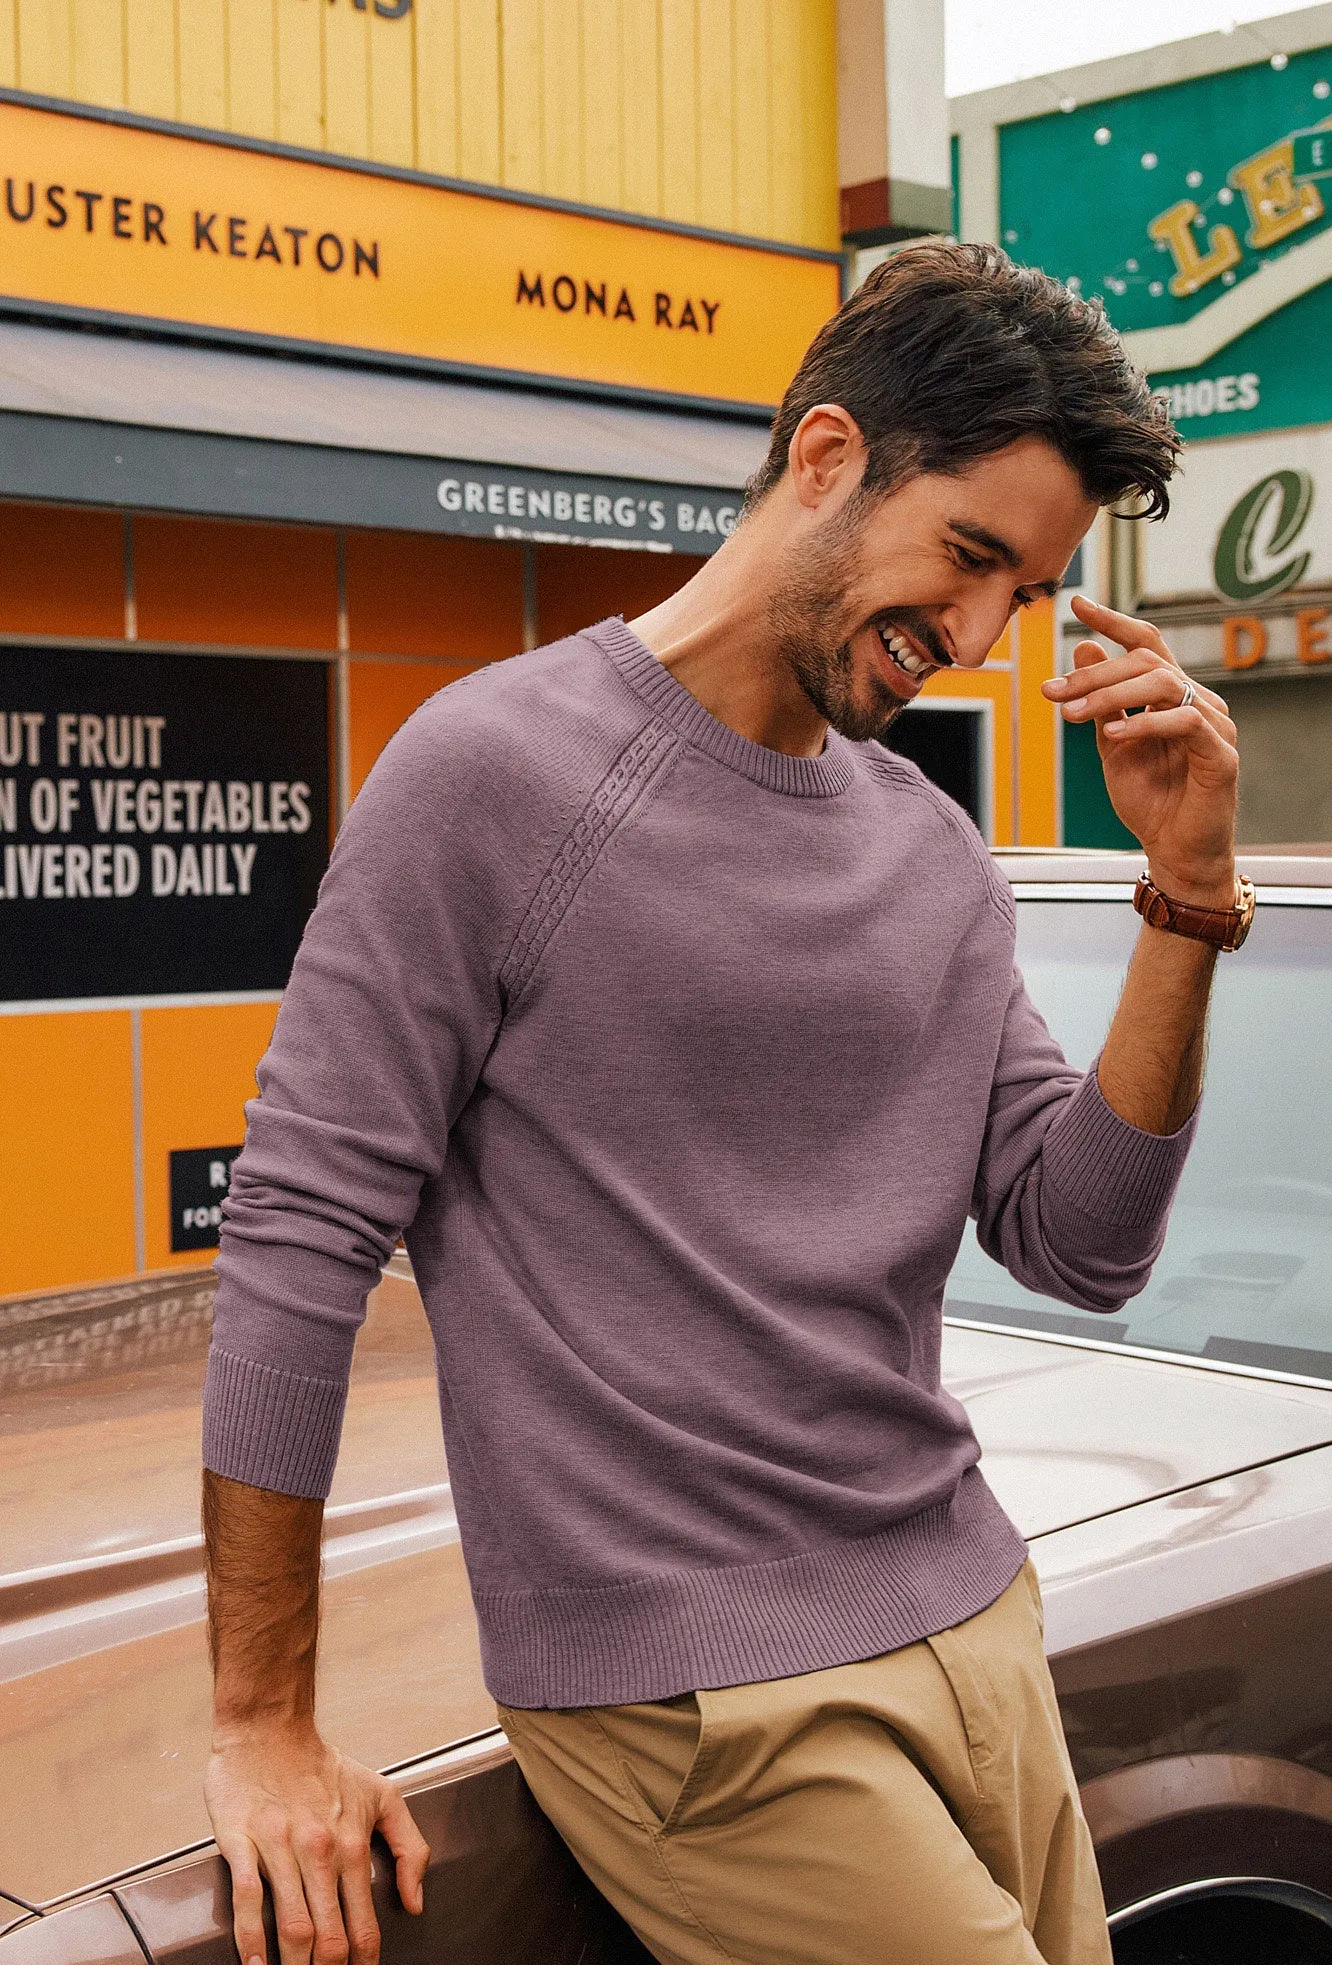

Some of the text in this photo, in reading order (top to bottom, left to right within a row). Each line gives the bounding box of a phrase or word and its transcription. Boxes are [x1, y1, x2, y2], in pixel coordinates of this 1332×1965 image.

[6, 178, 381, 279] USTER KEATON
[1148, 114, 1332, 297] LE
[515, 269, 721, 334] MONA RAY
[437, 479, 666, 532] GREENBERG'S
[57, 713, 167, 769] FRUIT
[29, 777, 81, 834] OF
[91, 778, 313, 834] VEGETABLES
[0, 843, 259, 899] IVERED DAILY
